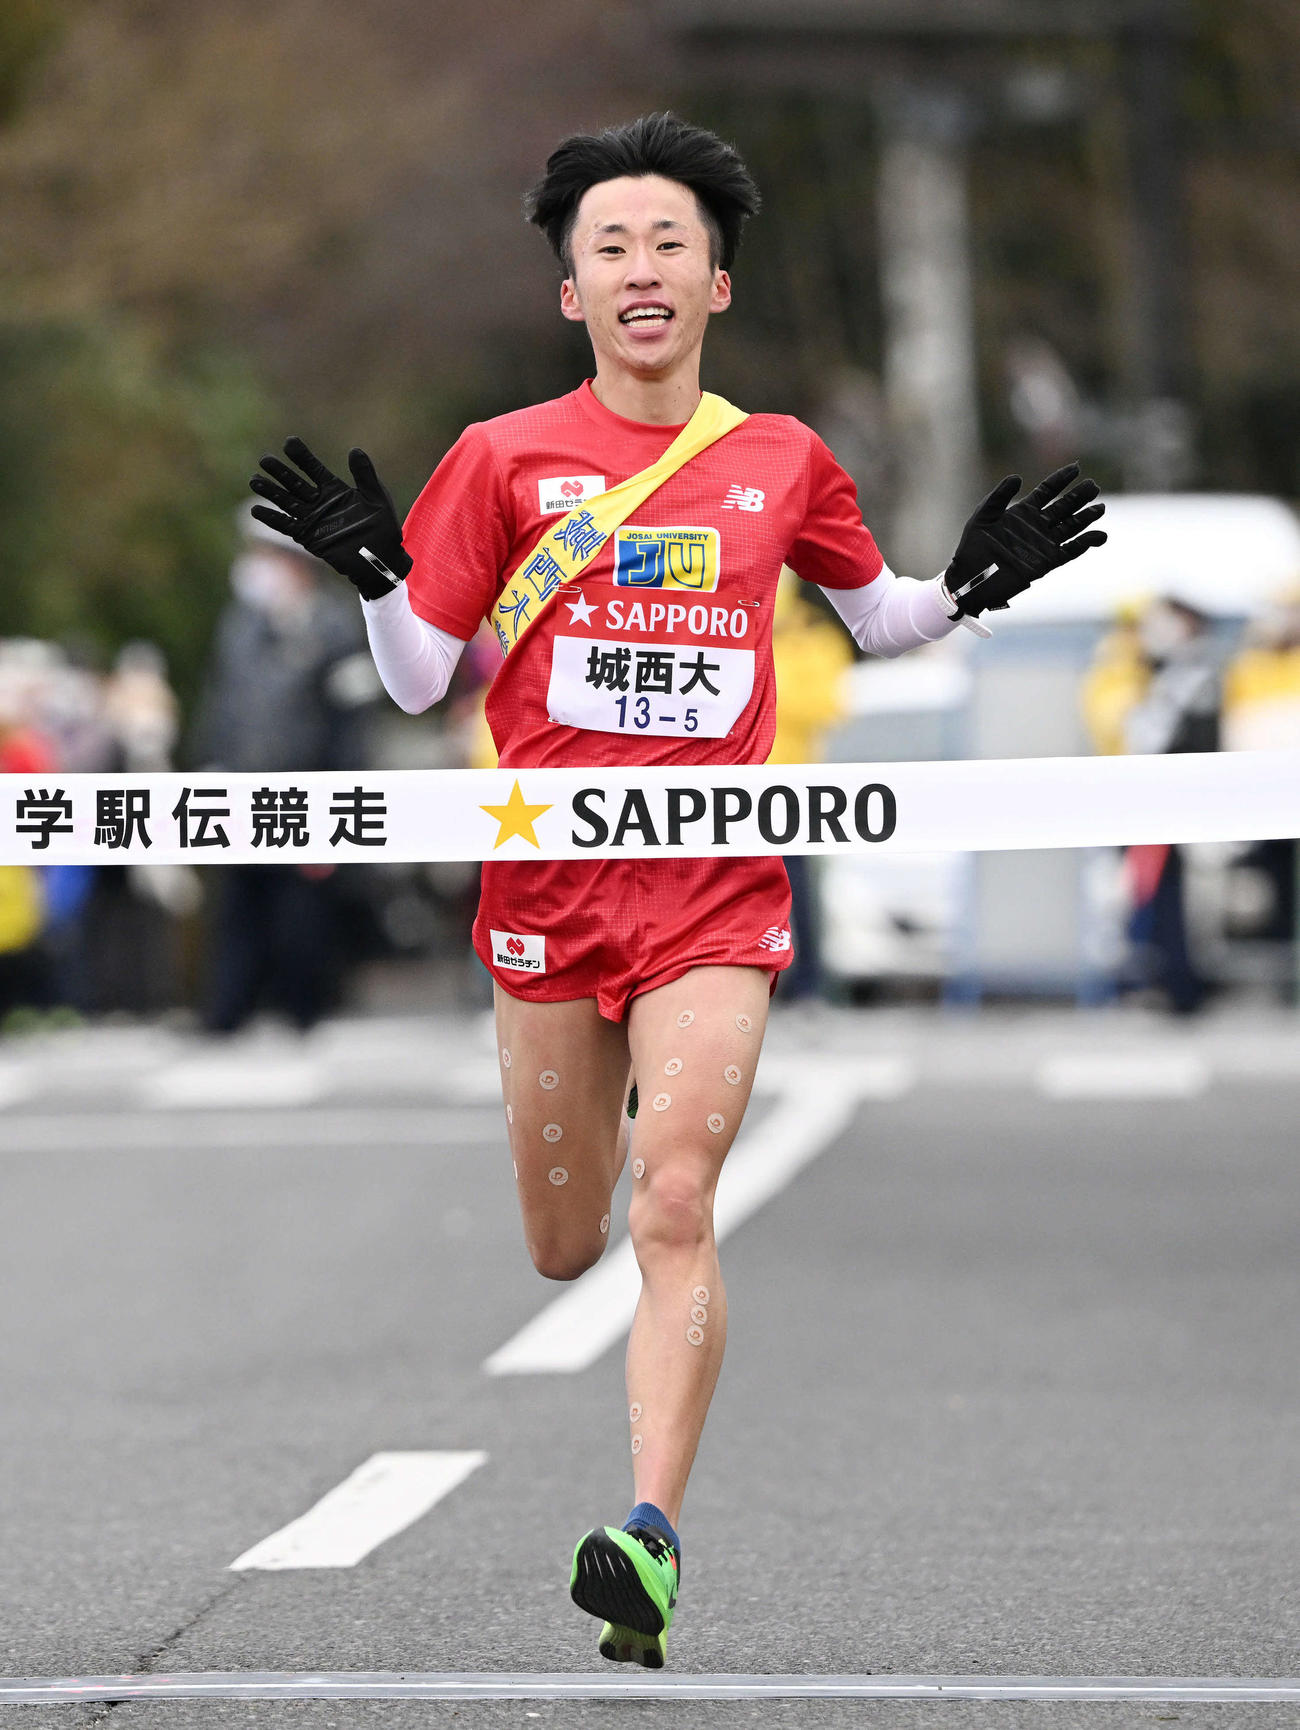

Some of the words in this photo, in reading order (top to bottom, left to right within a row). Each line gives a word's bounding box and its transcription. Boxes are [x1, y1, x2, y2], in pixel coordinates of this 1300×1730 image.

[546, 499, 588, 510] 新田ゼラ
[656, 532, 709, 541] UNIVERSITY
[628, 541, 706, 588] JU
[605, 600, 749, 639] SAPPORO
[585, 646, 721, 697] 城西大
[15, 786, 388, 850] 学駅伝競走
[571, 783, 897, 848] SAPPORO
